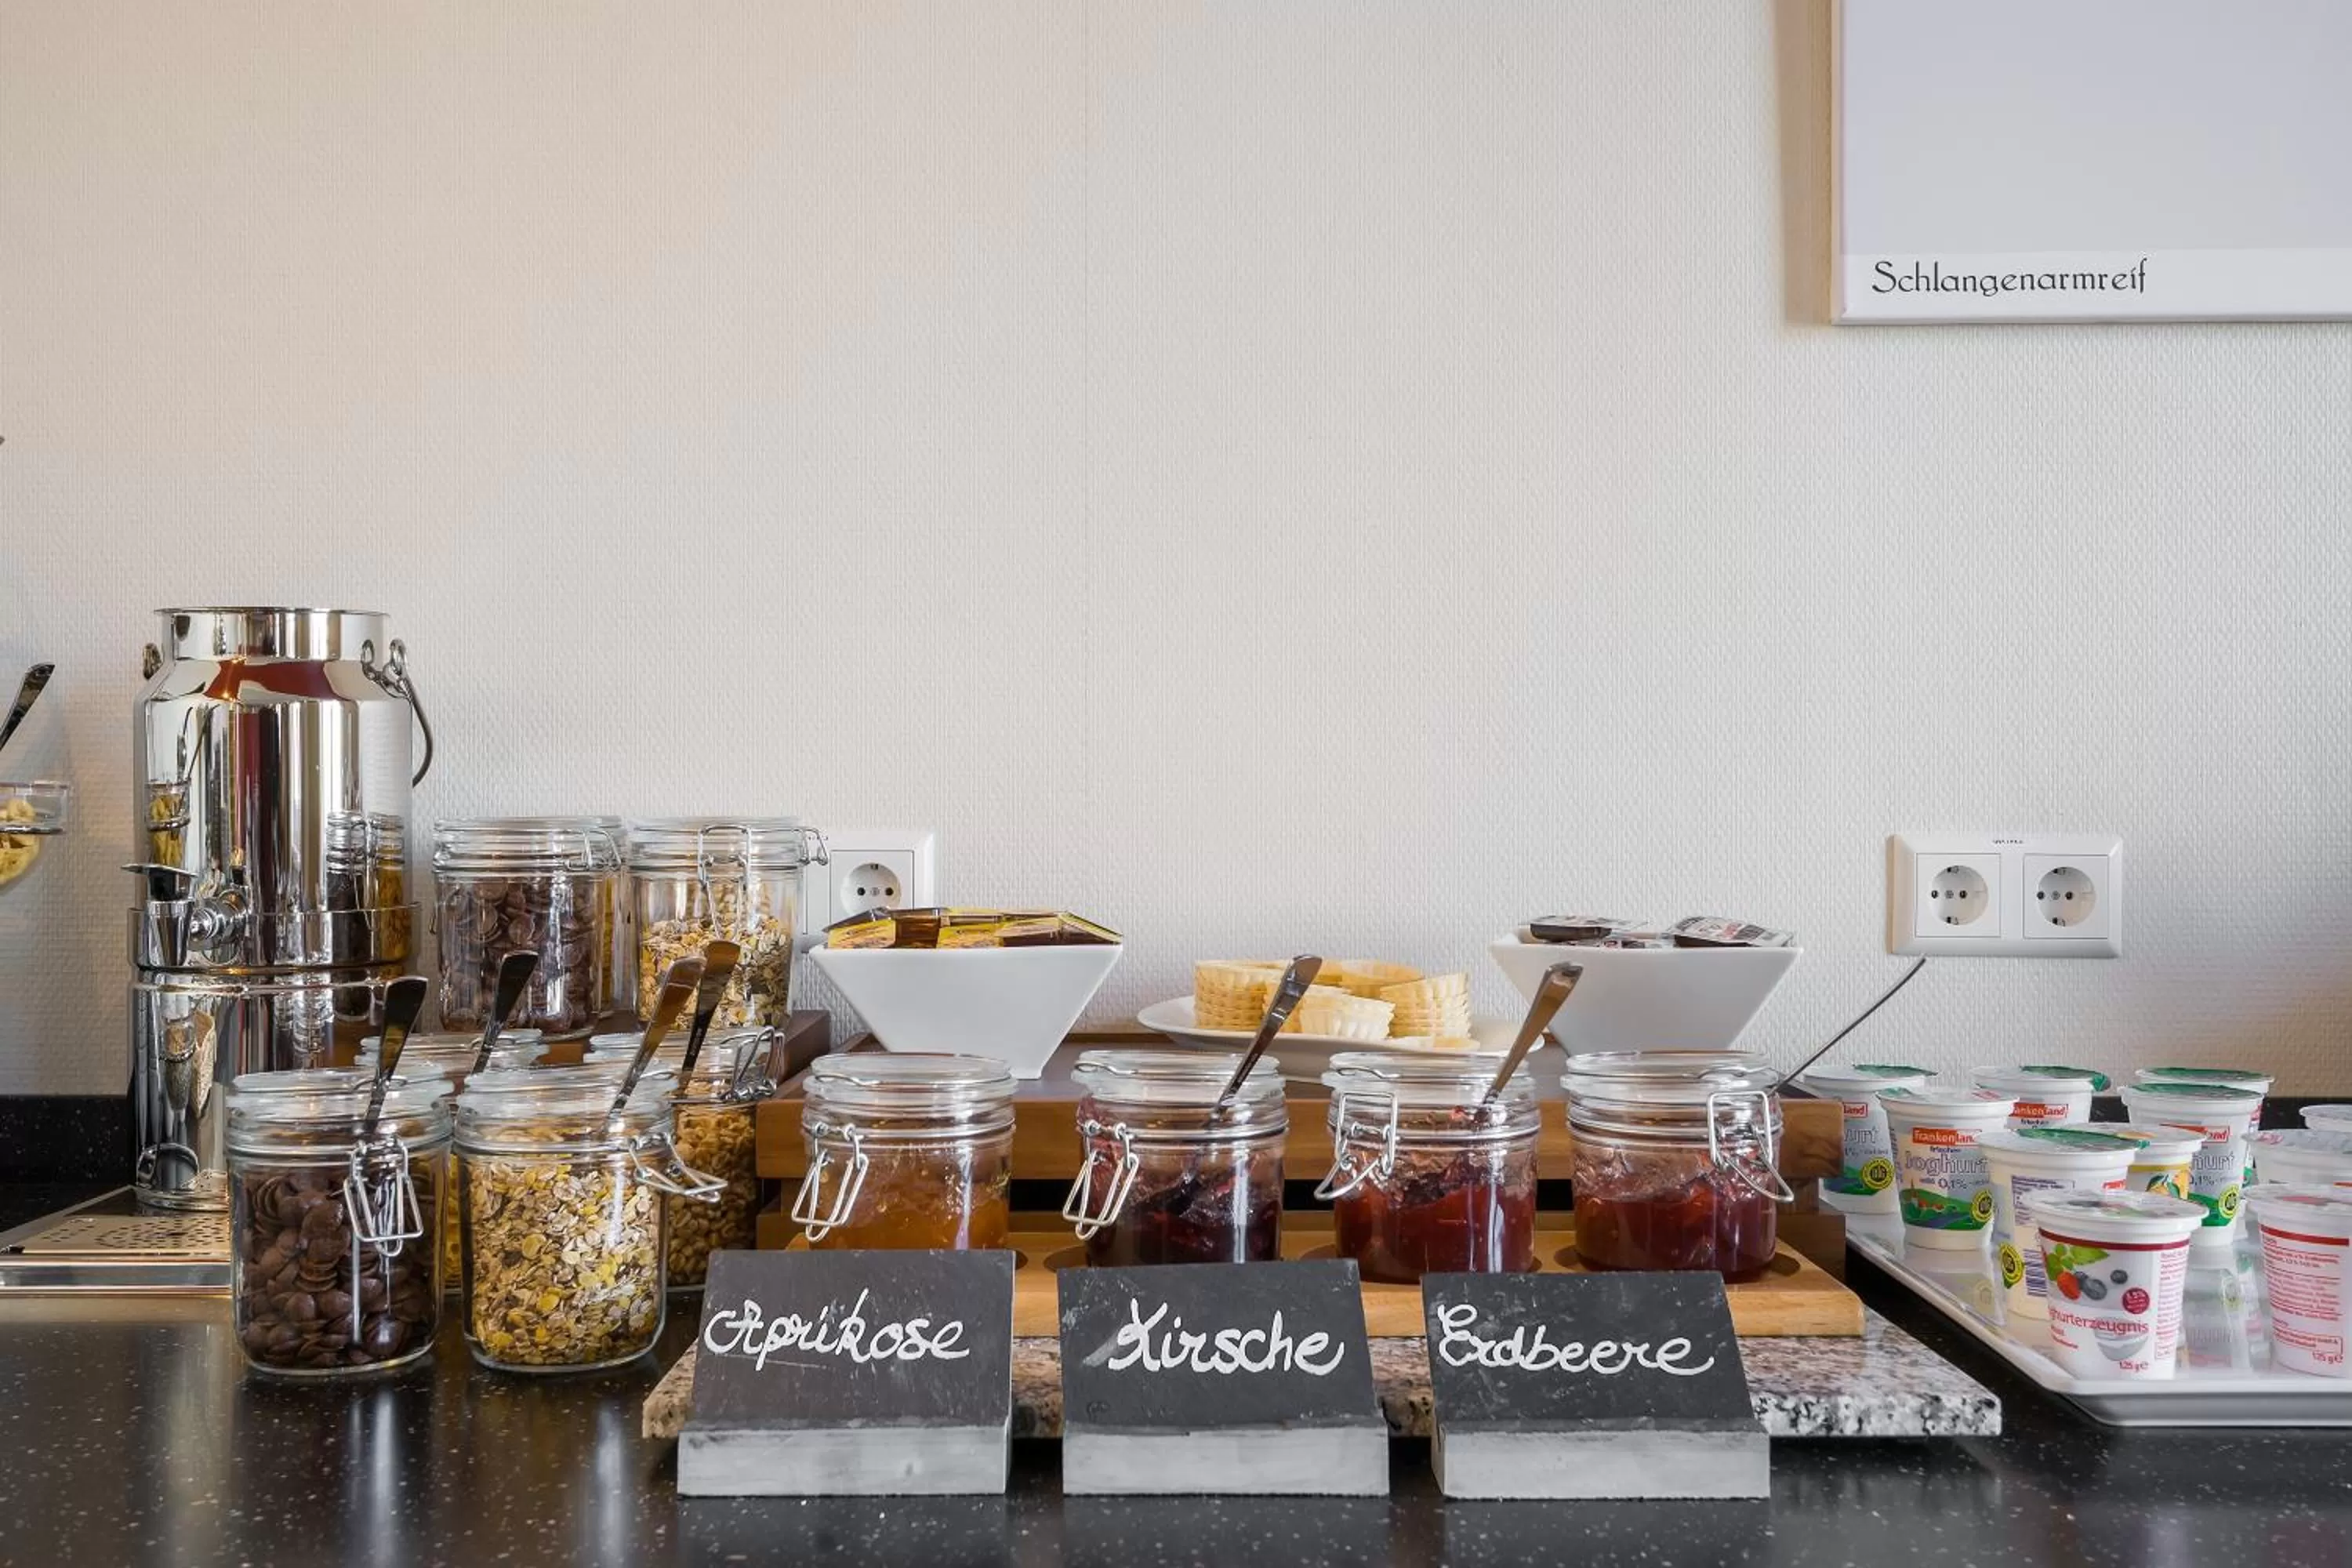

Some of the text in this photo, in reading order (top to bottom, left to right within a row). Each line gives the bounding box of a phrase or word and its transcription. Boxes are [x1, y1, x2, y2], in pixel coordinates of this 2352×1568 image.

[1871, 257, 2147, 297] Schlangenarmreif
[703, 1288, 970, 1371] Aprikose
[1108, 1298, 1345, 1376] Kirsche
[1437, 1303, 1715, 1376] Erdbeere
